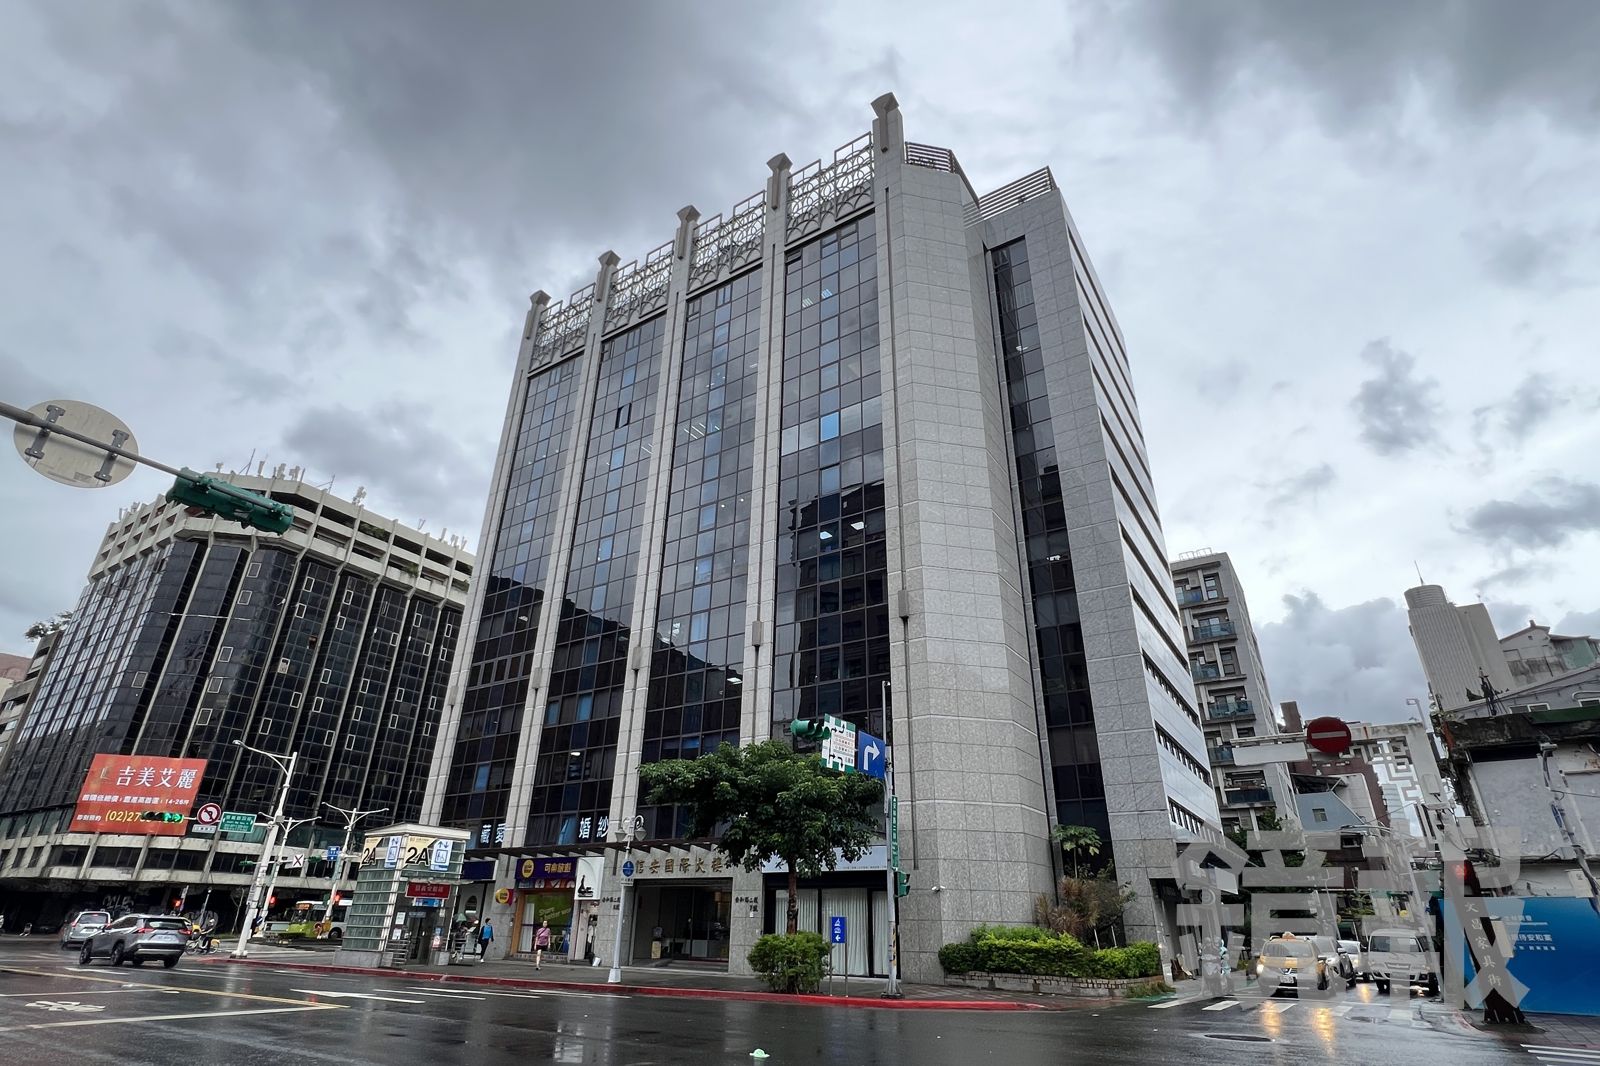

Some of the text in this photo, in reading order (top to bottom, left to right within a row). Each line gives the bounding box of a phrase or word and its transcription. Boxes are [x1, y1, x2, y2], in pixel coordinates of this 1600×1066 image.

[116, 765, 198, 789] 吉美艾麗
[578, 816, 609, 839] 婚紗
[361, 847, 376, 865] 2A
[405, 847, 430, 866] 2A
[635, 857, 723, 874] 信安國際大樓
[1465, 901, 1502, 987] 文昌家具街
